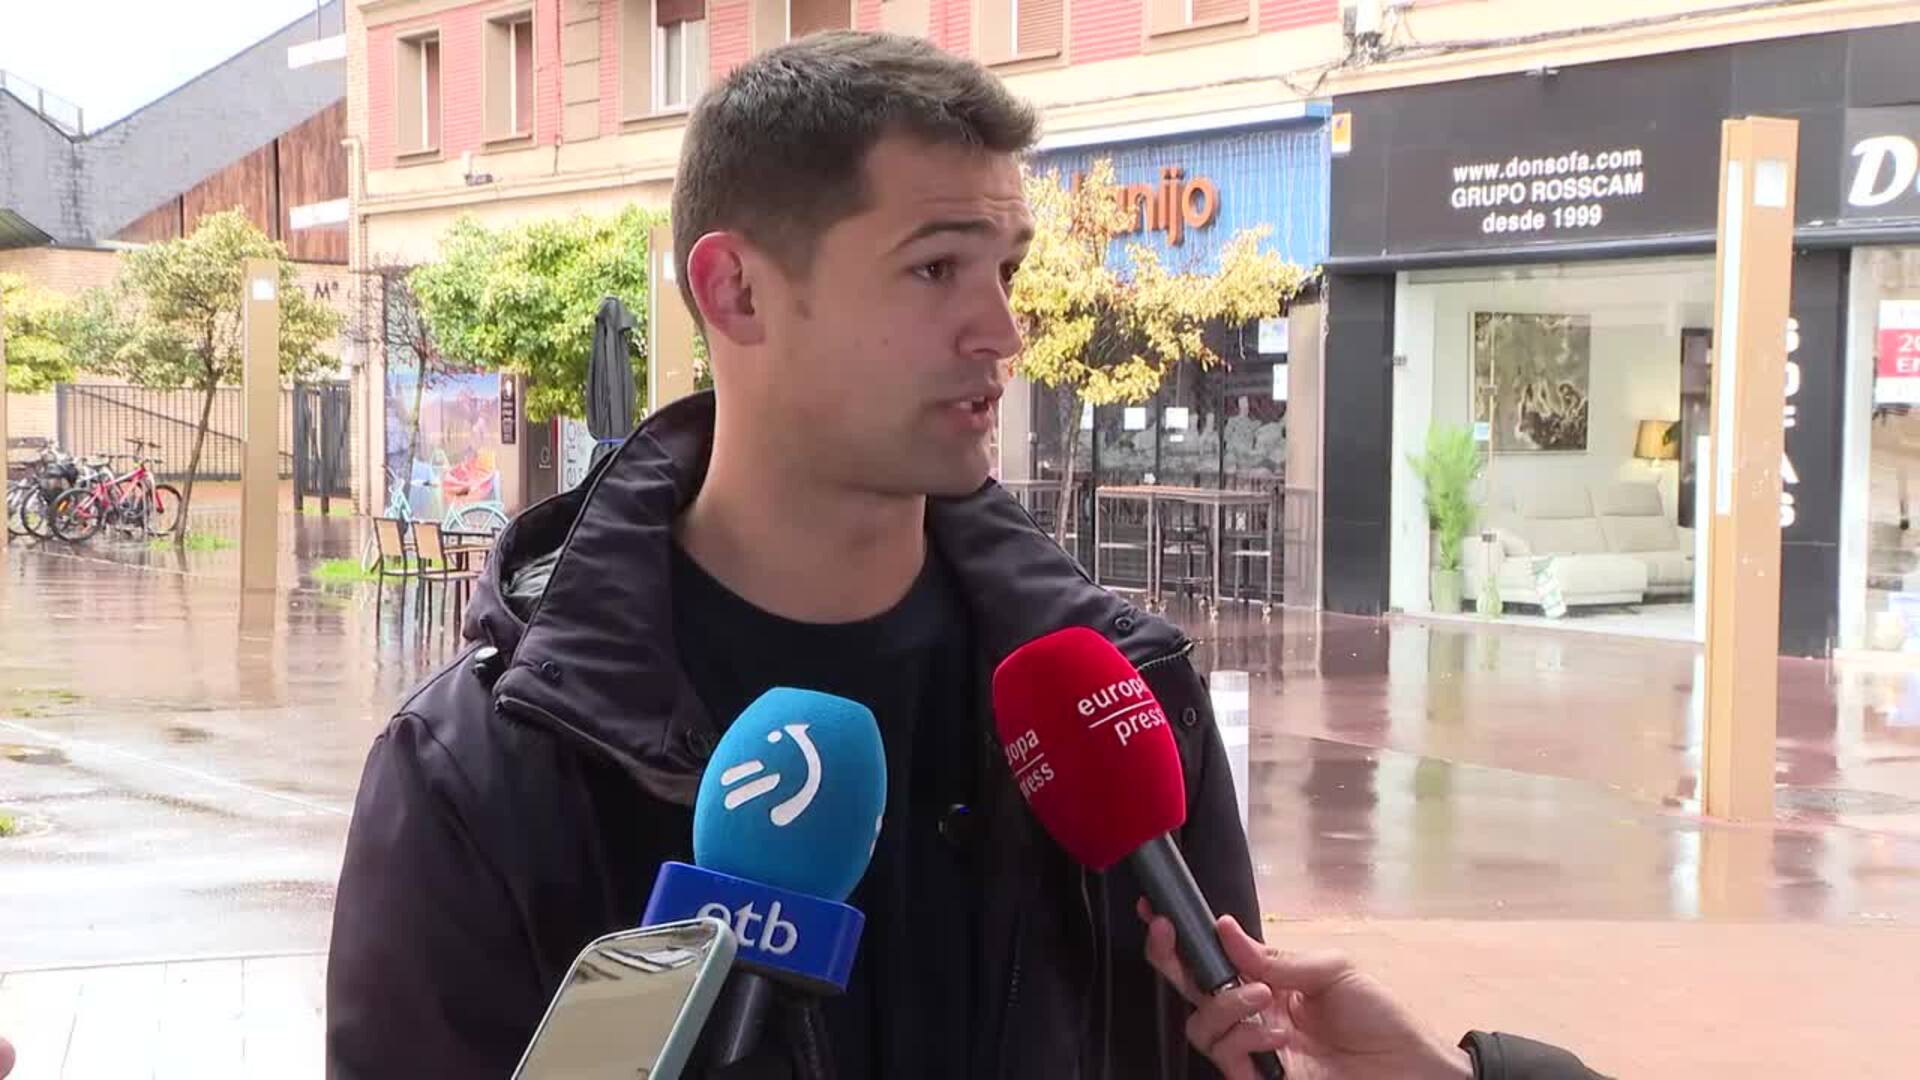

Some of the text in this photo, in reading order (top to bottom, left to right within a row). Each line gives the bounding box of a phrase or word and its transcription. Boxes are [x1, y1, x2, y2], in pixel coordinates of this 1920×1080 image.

[1453, 149, 1643, 183] www.donsofa.com
[1848, 135, 1920, 206] D
[1451, 171, 1644, 208] GRUPO ROSSCAM
[1482, 204, 1603, 233] desde 1999
[1077, 675, 1150, 716] europ
[1114, 707, 1166, 747] press
[1005, 729, 1040, 767] opa
[1019, 762, 1055, 804] ess
